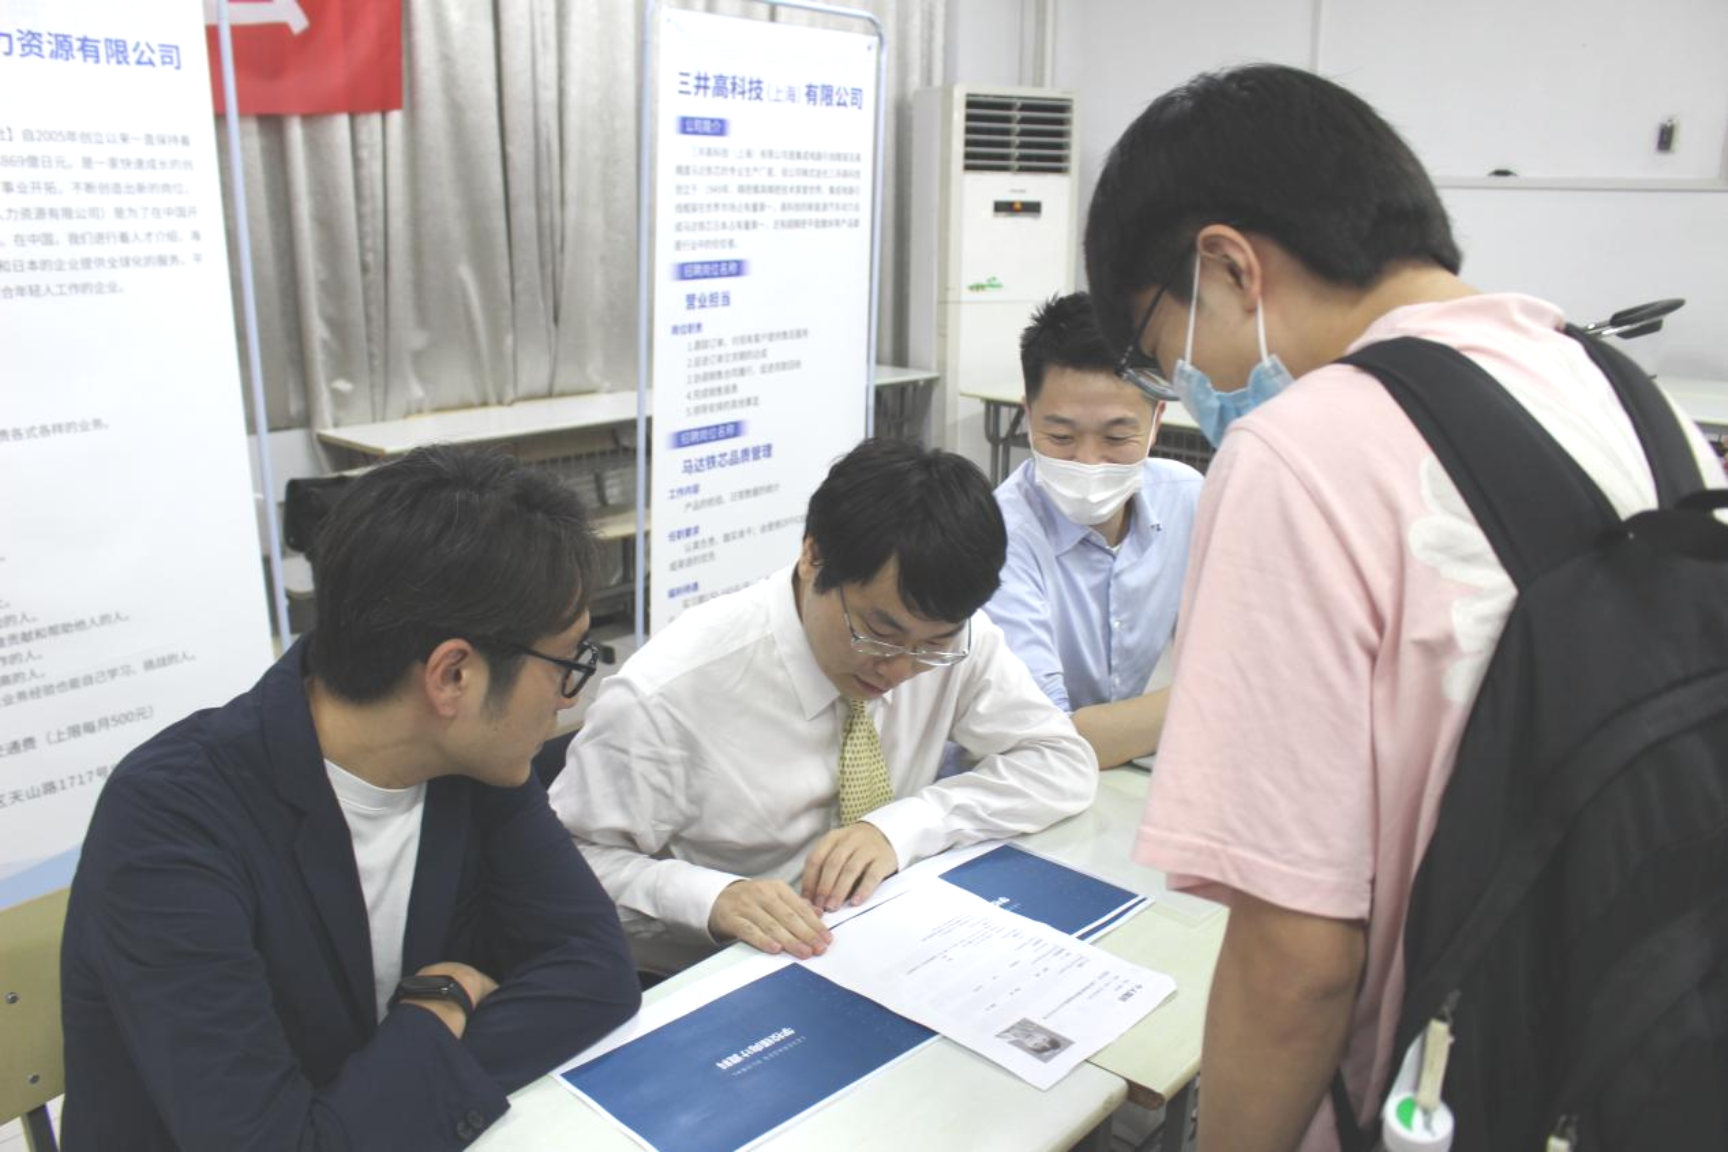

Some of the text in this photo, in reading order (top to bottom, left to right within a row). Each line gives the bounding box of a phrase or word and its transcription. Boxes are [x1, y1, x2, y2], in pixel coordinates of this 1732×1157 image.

[0, 207, 198, 221] 力资源有限公司）是为了在中国开
[685, 291, 731, 311] 营业担当
[682, 444, 772, 474] 马达铁芯品质管理
[0, 612, 38, 629] 的人。
[0, 762, 116, 810] 天山路1717号
